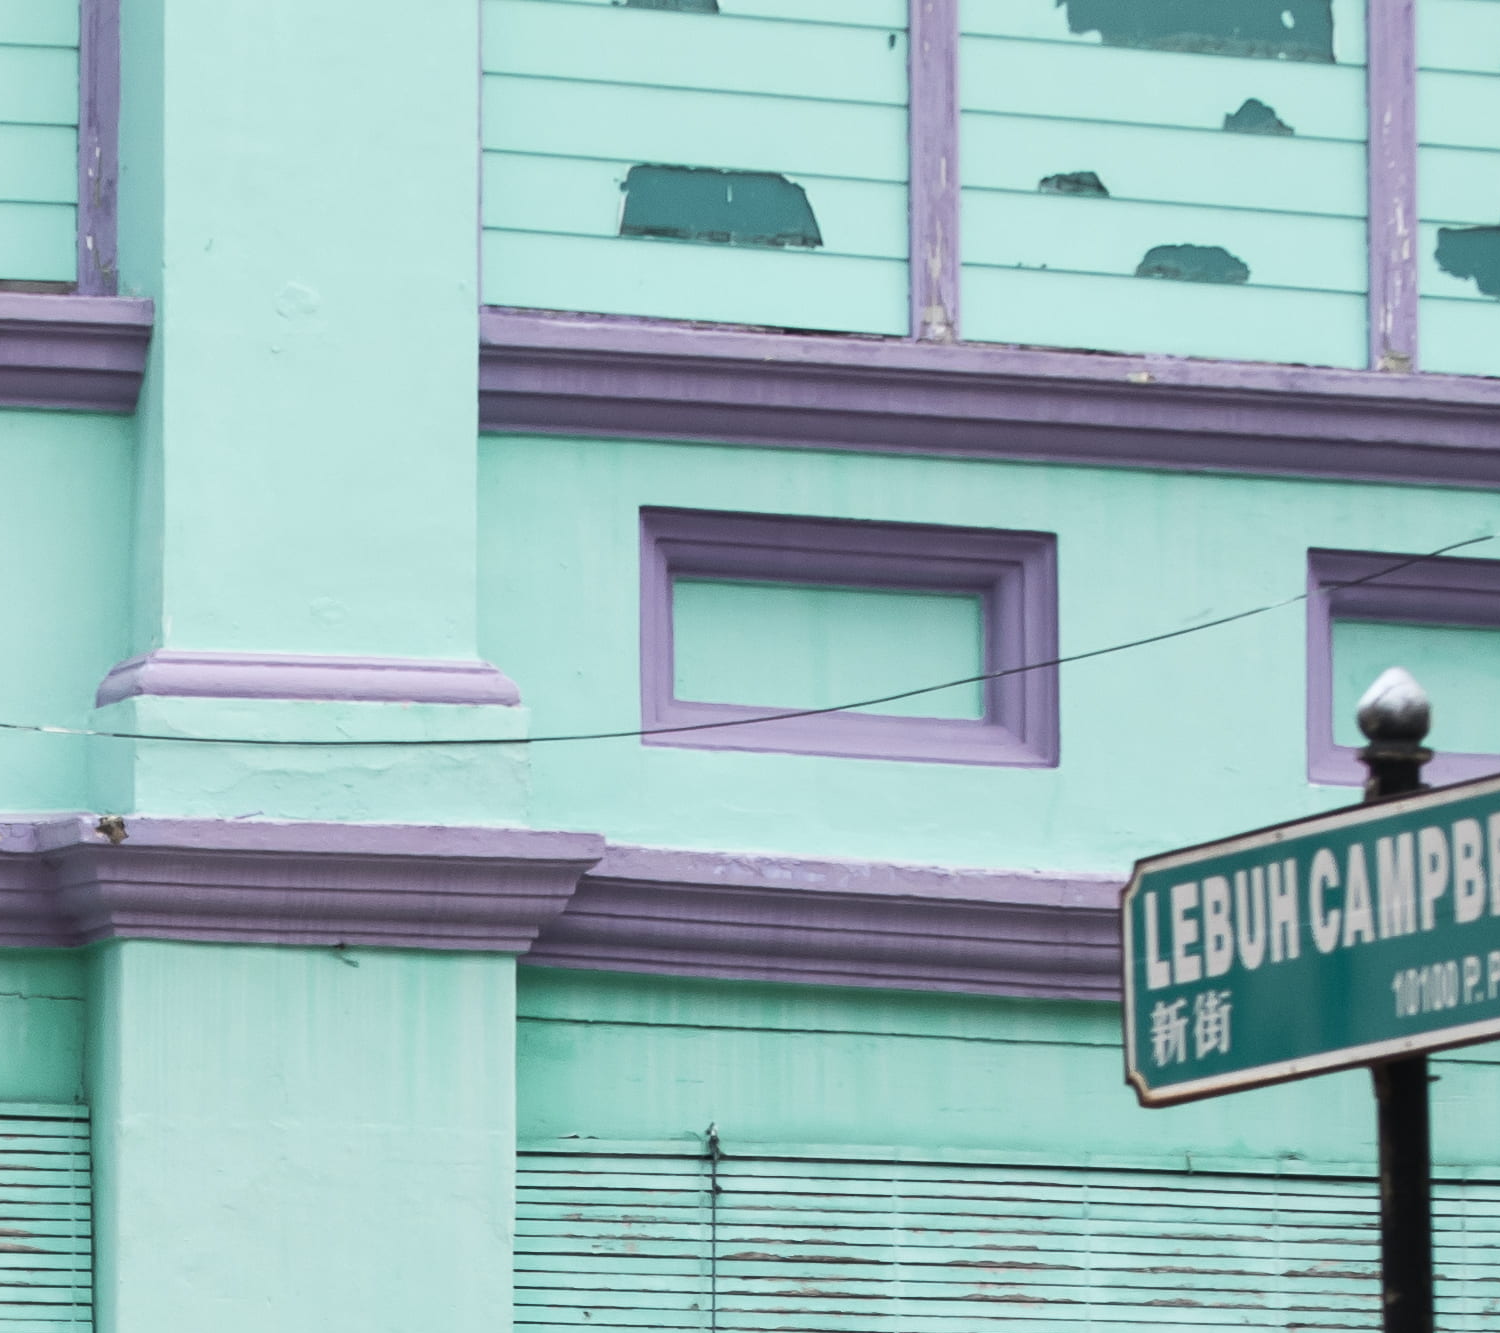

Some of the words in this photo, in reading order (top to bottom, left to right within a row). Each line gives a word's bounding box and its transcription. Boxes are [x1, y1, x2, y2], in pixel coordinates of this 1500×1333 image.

[1144, 858, 1300, 989] LEBUH
[1392, 960, 1459, 1018] 10100
[1150, 990, 1232, 1067] 新街
